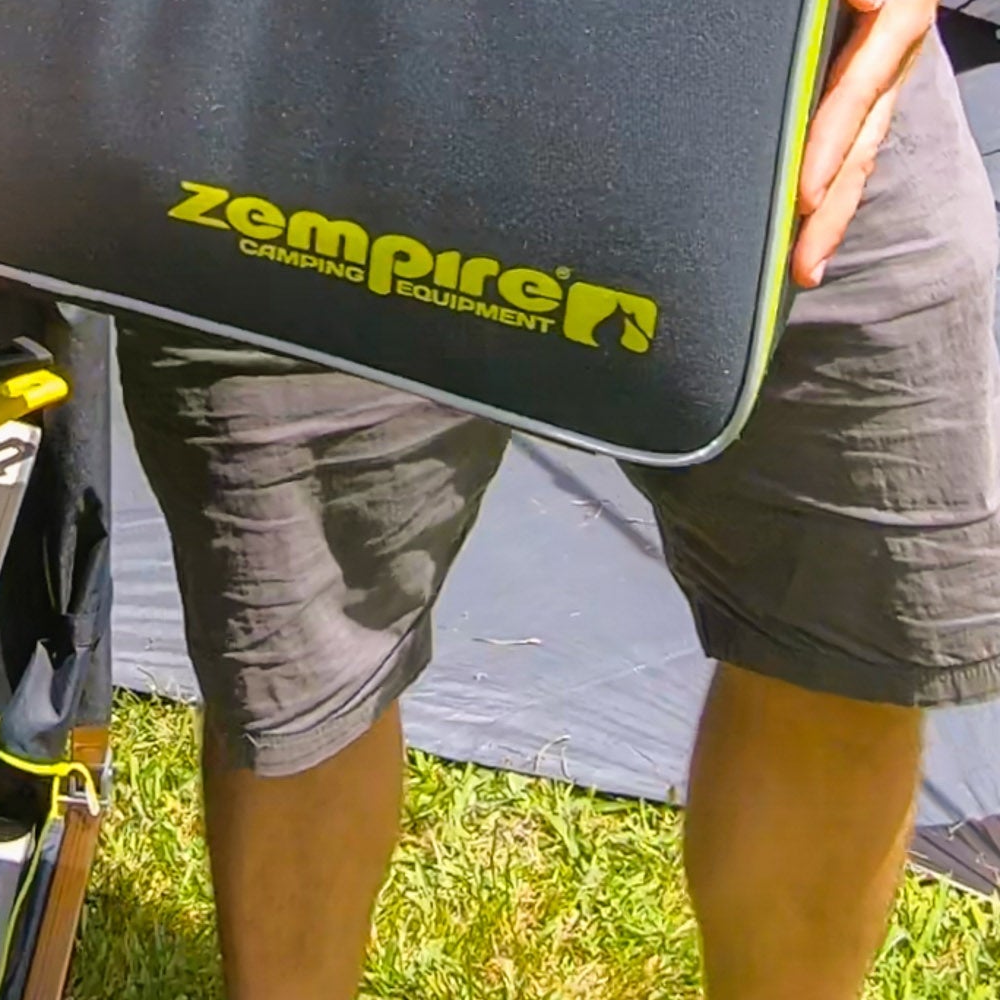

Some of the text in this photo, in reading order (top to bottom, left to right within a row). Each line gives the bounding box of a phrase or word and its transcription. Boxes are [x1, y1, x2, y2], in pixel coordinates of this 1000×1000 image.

[167, 180, 563, 313] zempire
[239, 238, 555, 334] CAMPING EQUIPMENT
